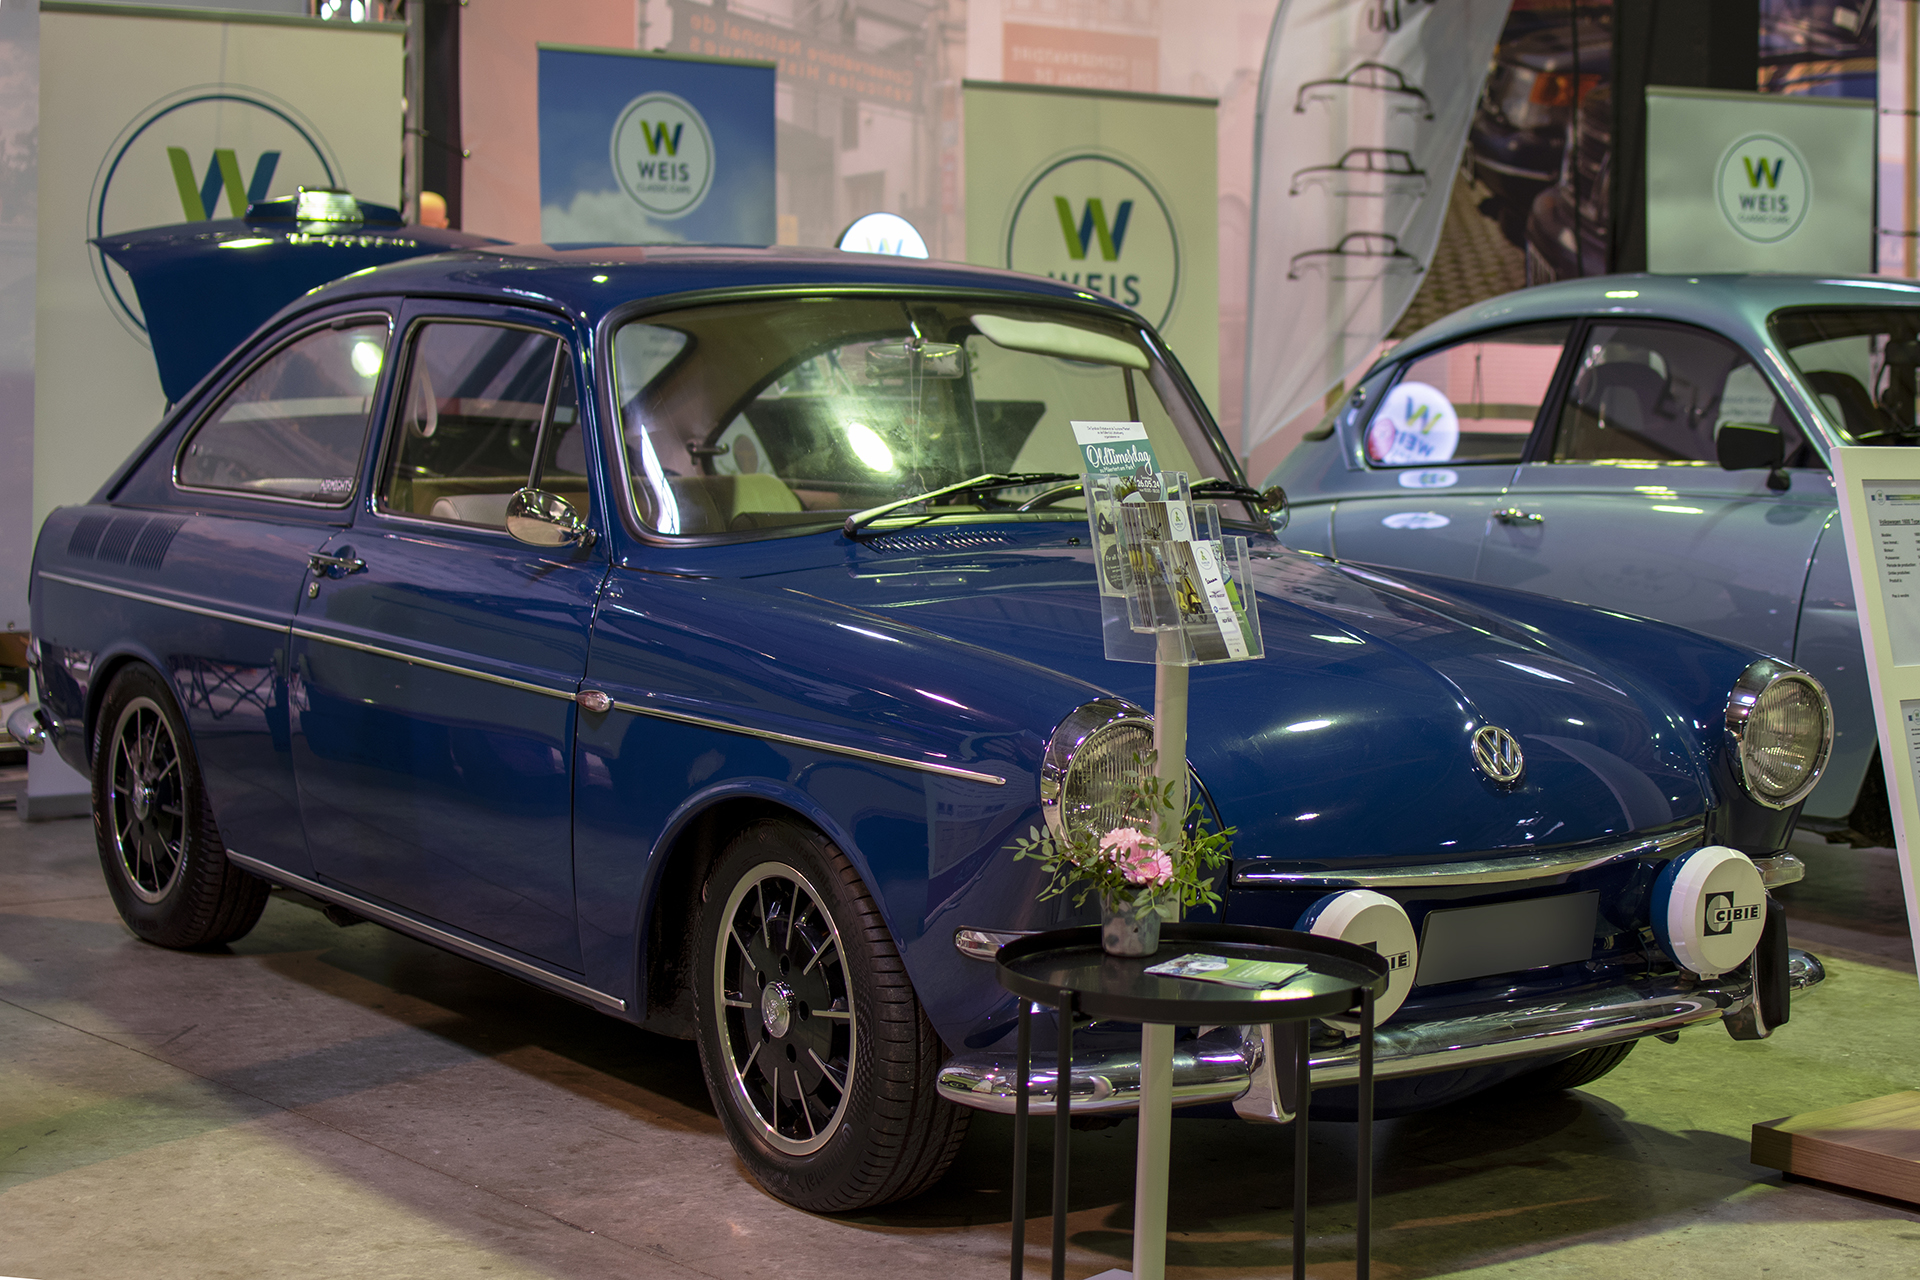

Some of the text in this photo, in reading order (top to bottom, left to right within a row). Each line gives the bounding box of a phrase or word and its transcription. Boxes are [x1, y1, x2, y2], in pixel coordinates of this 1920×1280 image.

[637, 161, 690, 181] WEIS
[1739, 193, 1789, 213] WEIS
[1049, 271, 1141, 307] EIS
[1136, 479, 1160, 488] 26.05.24
[786, 834, 842, 908] UltraContact
